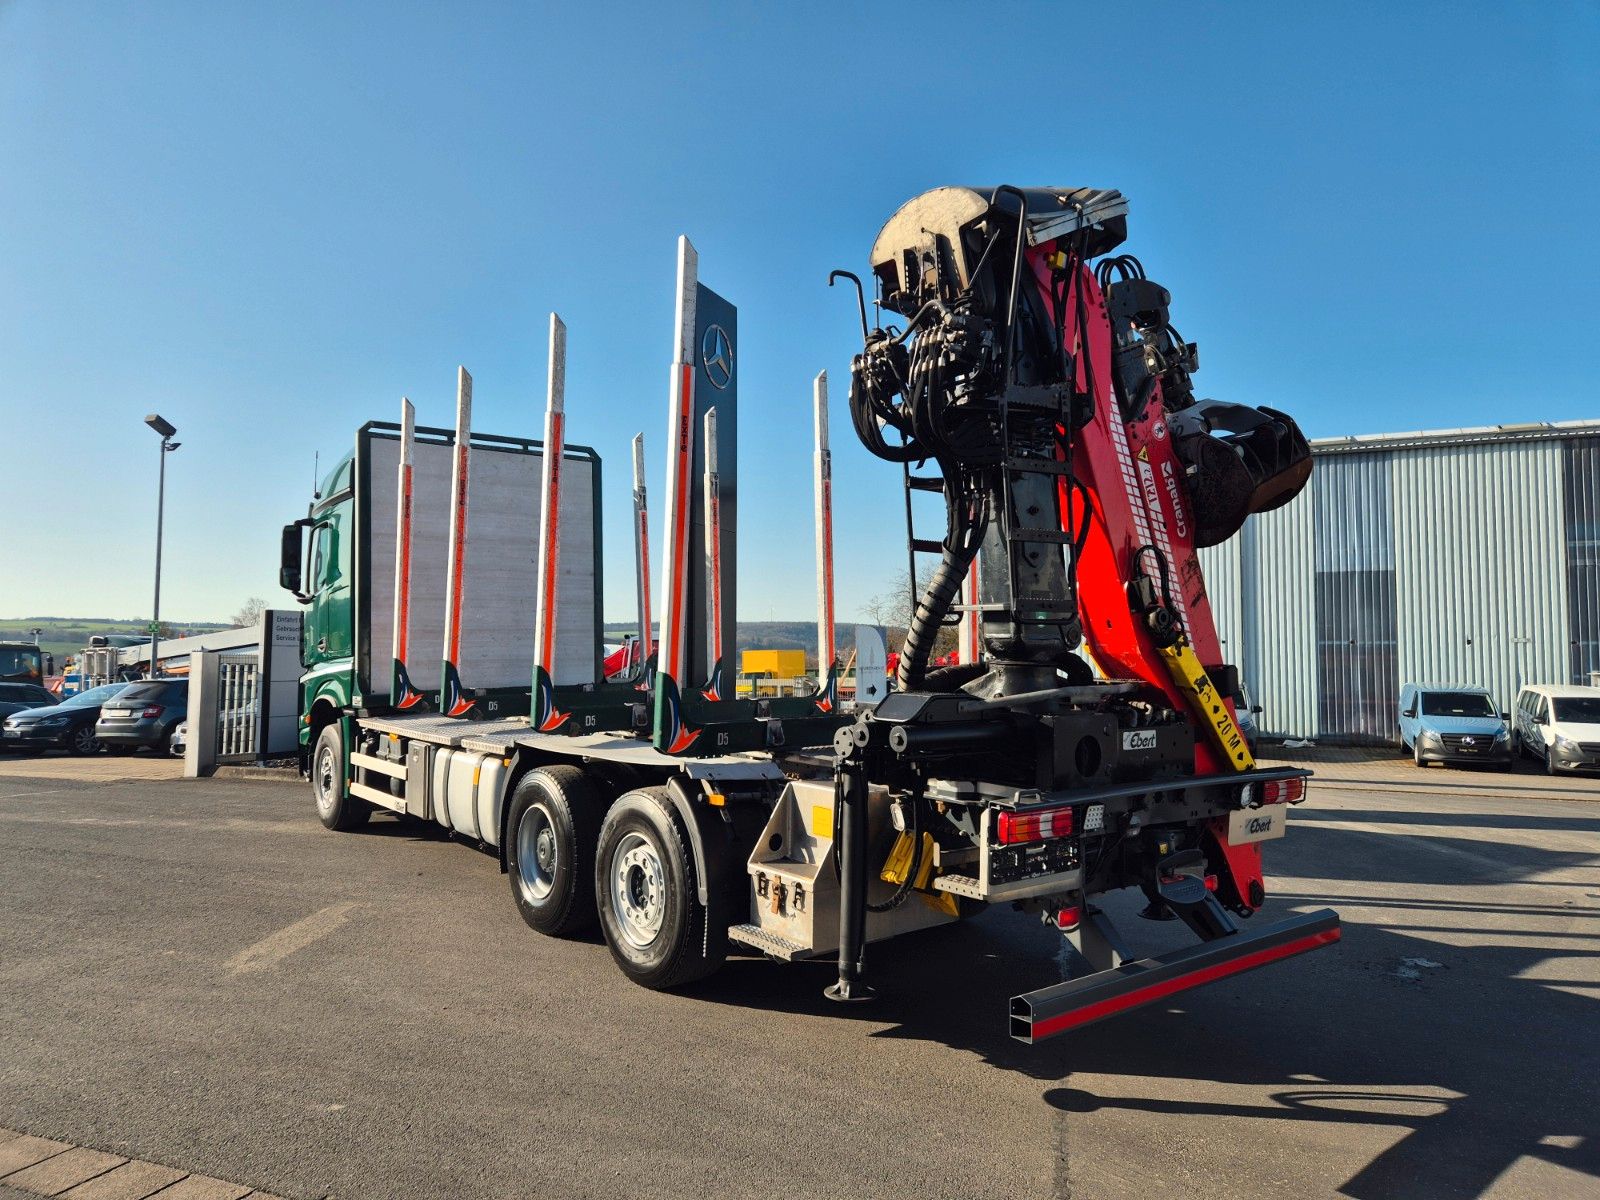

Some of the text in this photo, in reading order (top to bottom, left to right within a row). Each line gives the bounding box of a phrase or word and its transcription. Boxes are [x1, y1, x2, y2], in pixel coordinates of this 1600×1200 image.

[1166, 477, 1187, 538] Cranab
[488, 701, 498, 711] D5
[585, 715, 596, 727] D5
[717, 732, 729, 746] D5
[1130, 732, 1156, 748] Ebert
[1217, 714, 1241, 752] 20 M
[1250, 817, 1272, 834] Ebert
